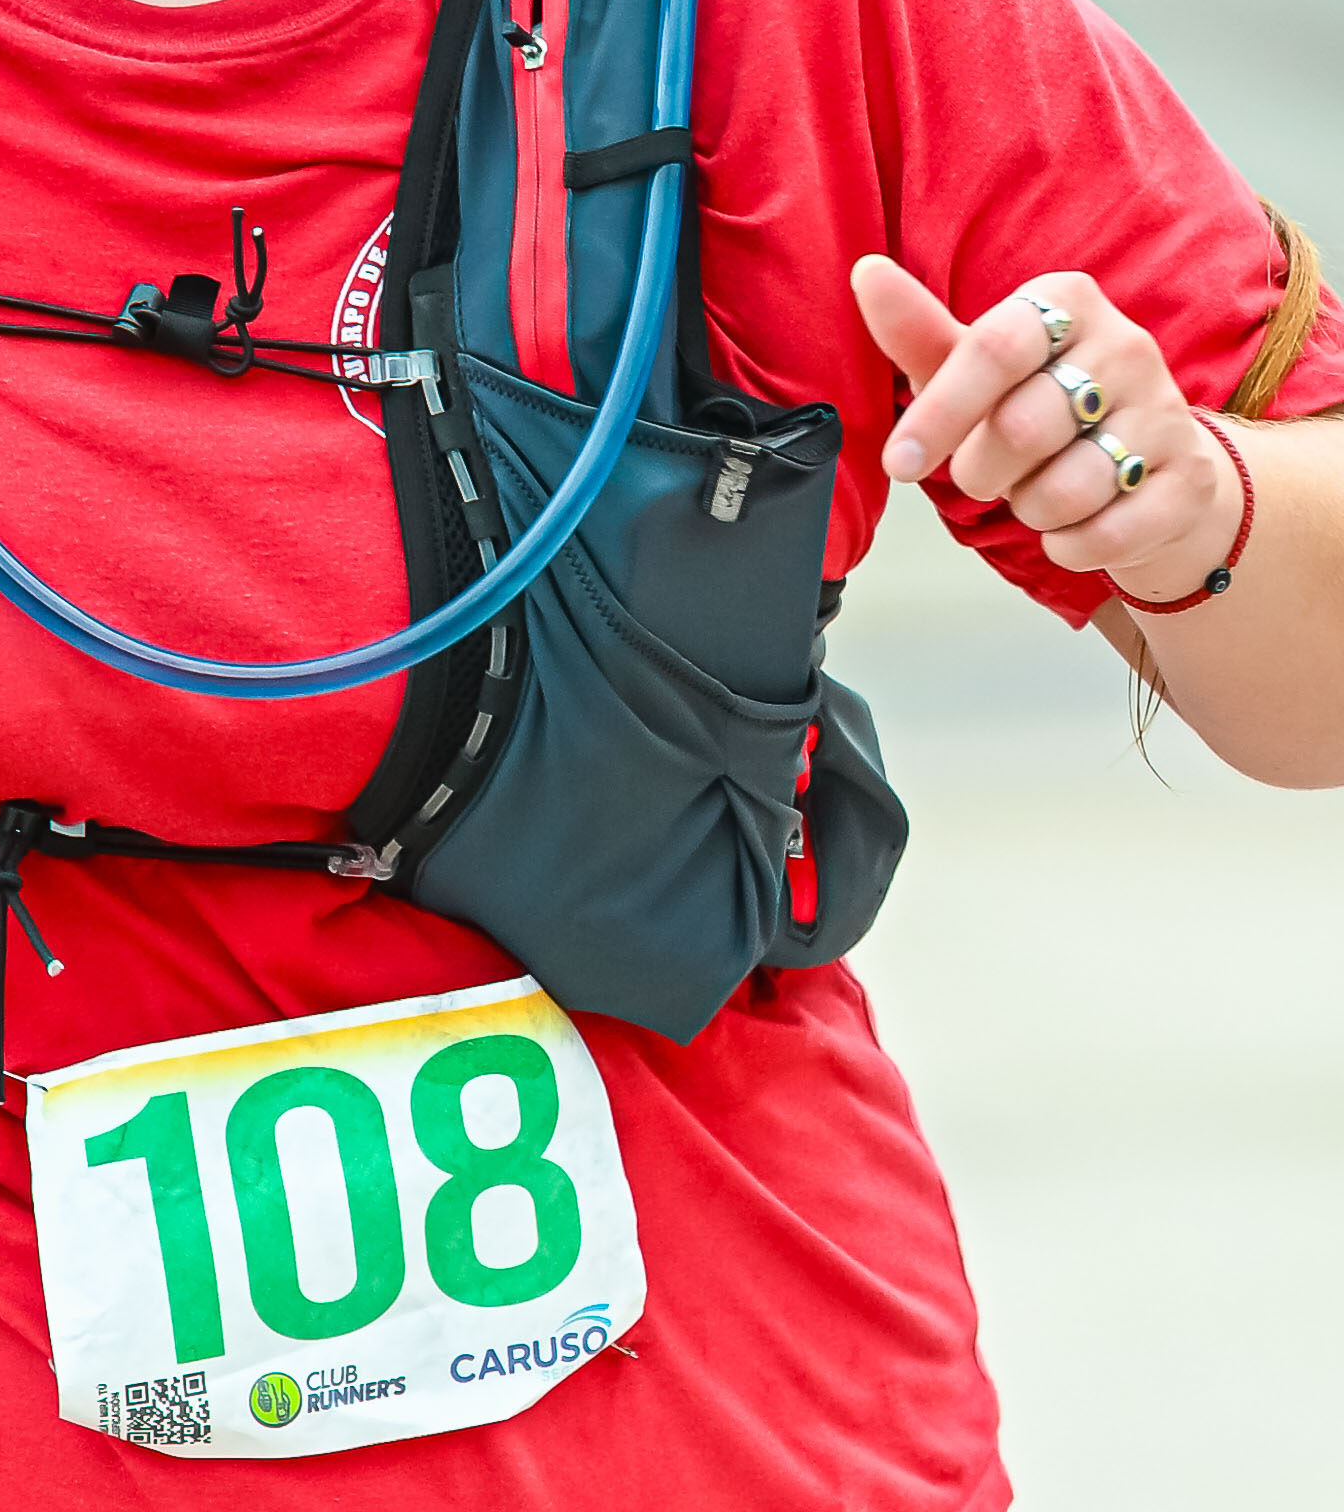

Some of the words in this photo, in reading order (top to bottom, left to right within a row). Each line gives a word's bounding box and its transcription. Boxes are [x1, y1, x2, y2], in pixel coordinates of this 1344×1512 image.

[340, 289, 371, 392] URPO
[84, 1033, 582, 1365] 108
[306, 1364, 358, 1391] CLUB
[450, 1325, 608, 1383] CARUSO
[307, 1375, 406, 1413] RUNNER'S
